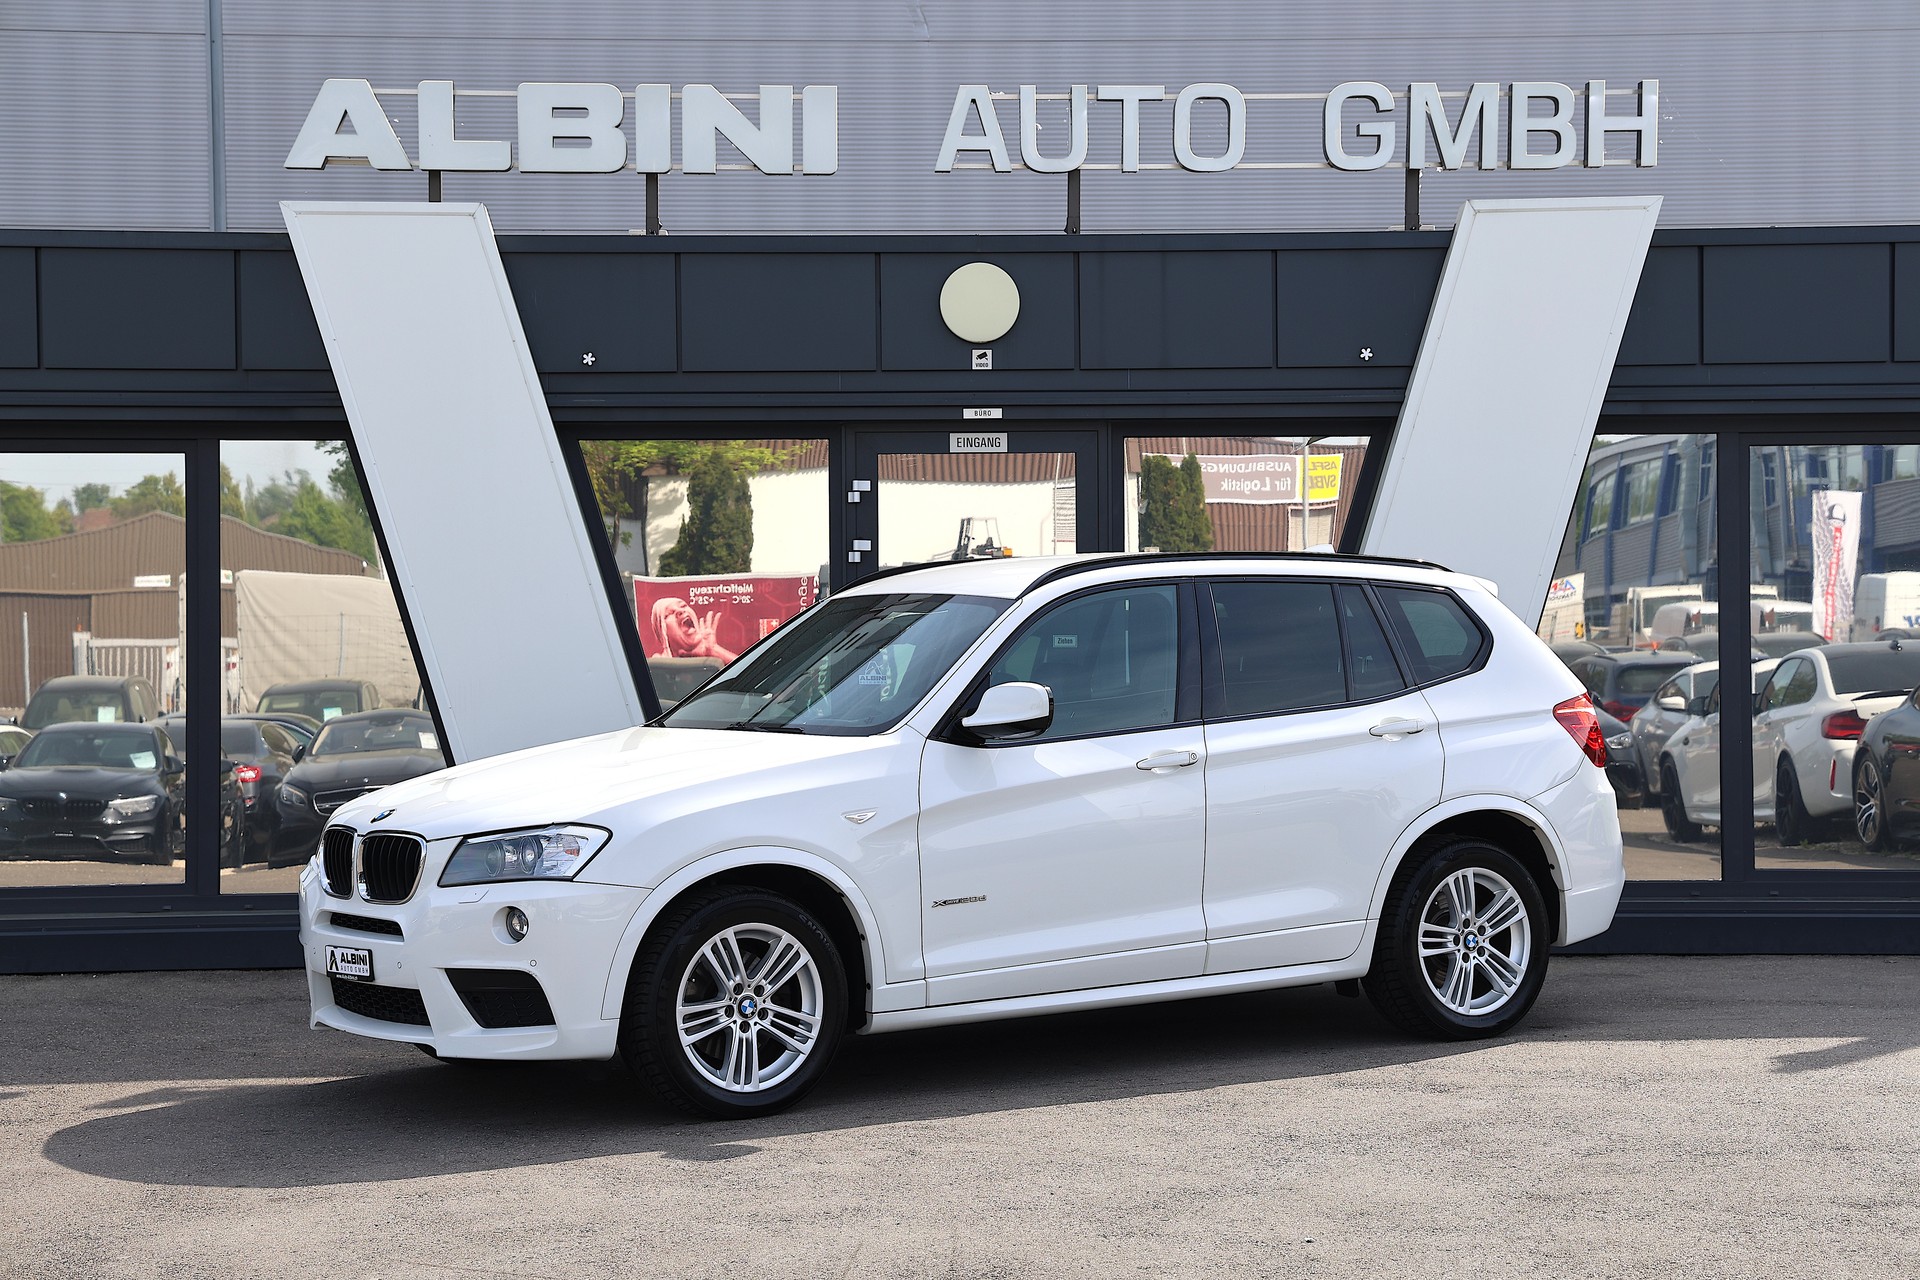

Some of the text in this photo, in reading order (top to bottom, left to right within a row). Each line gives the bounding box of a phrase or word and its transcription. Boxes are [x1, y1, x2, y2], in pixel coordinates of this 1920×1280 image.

[284, 78, 1659, 176] ALBINI AUTO GMBH
[956, 437, 1001, 448] EINGANG
[341, 952, 367, 966] ALBINI
